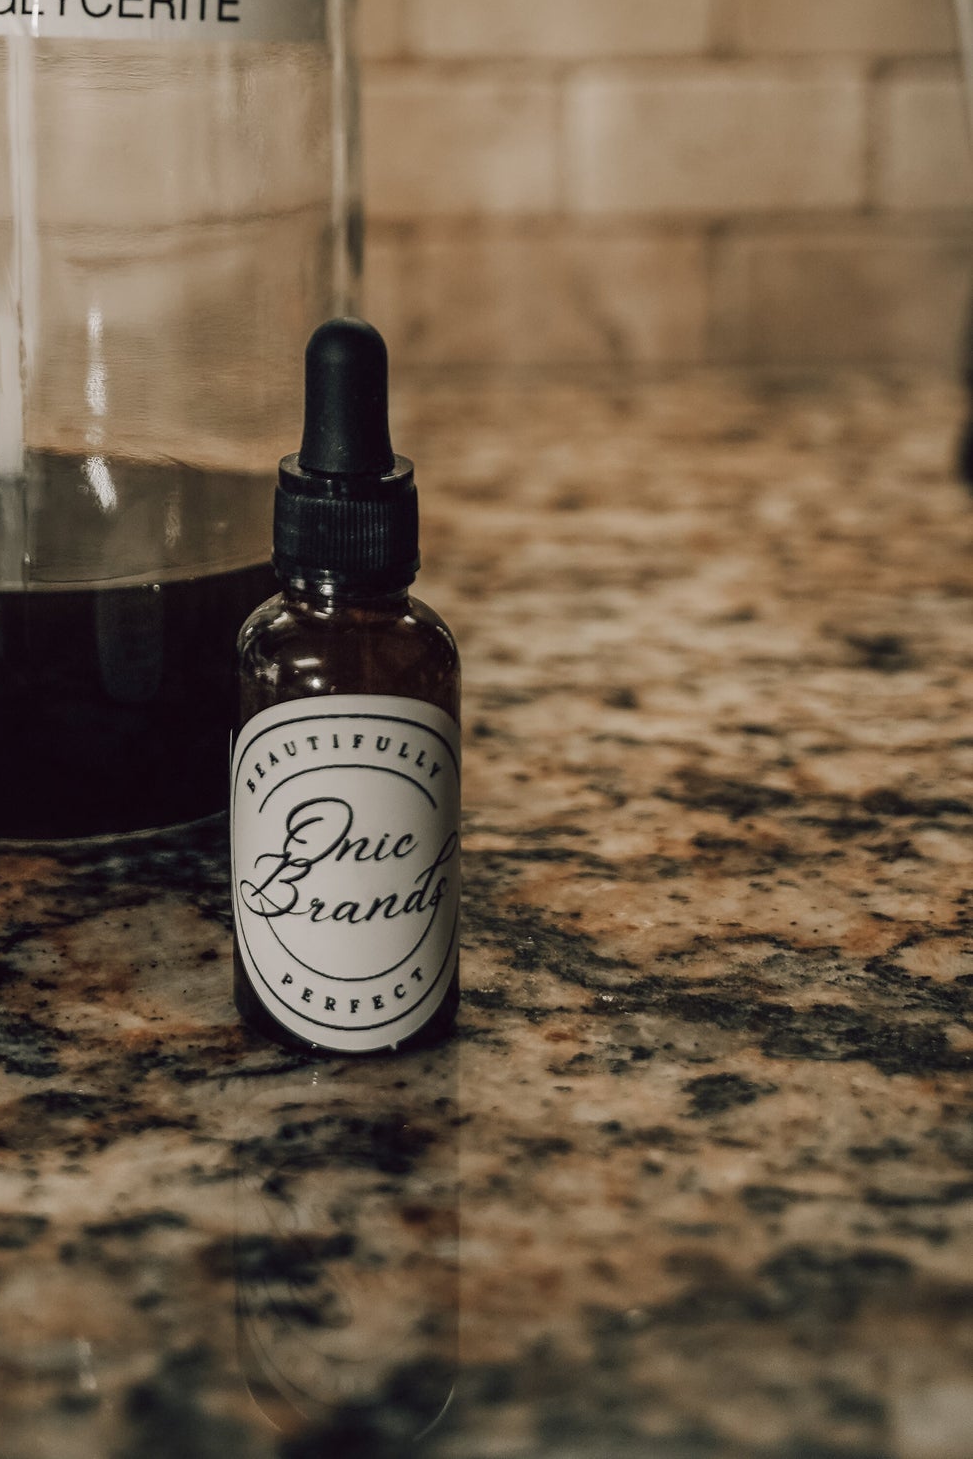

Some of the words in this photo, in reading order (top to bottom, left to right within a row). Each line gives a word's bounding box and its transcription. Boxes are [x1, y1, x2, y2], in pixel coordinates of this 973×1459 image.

[246, 733, 442, 795] BEAUTIFULLY
[240, 831, 458, 925] Brands
[280, 967, 424, 1014] PERFECT
